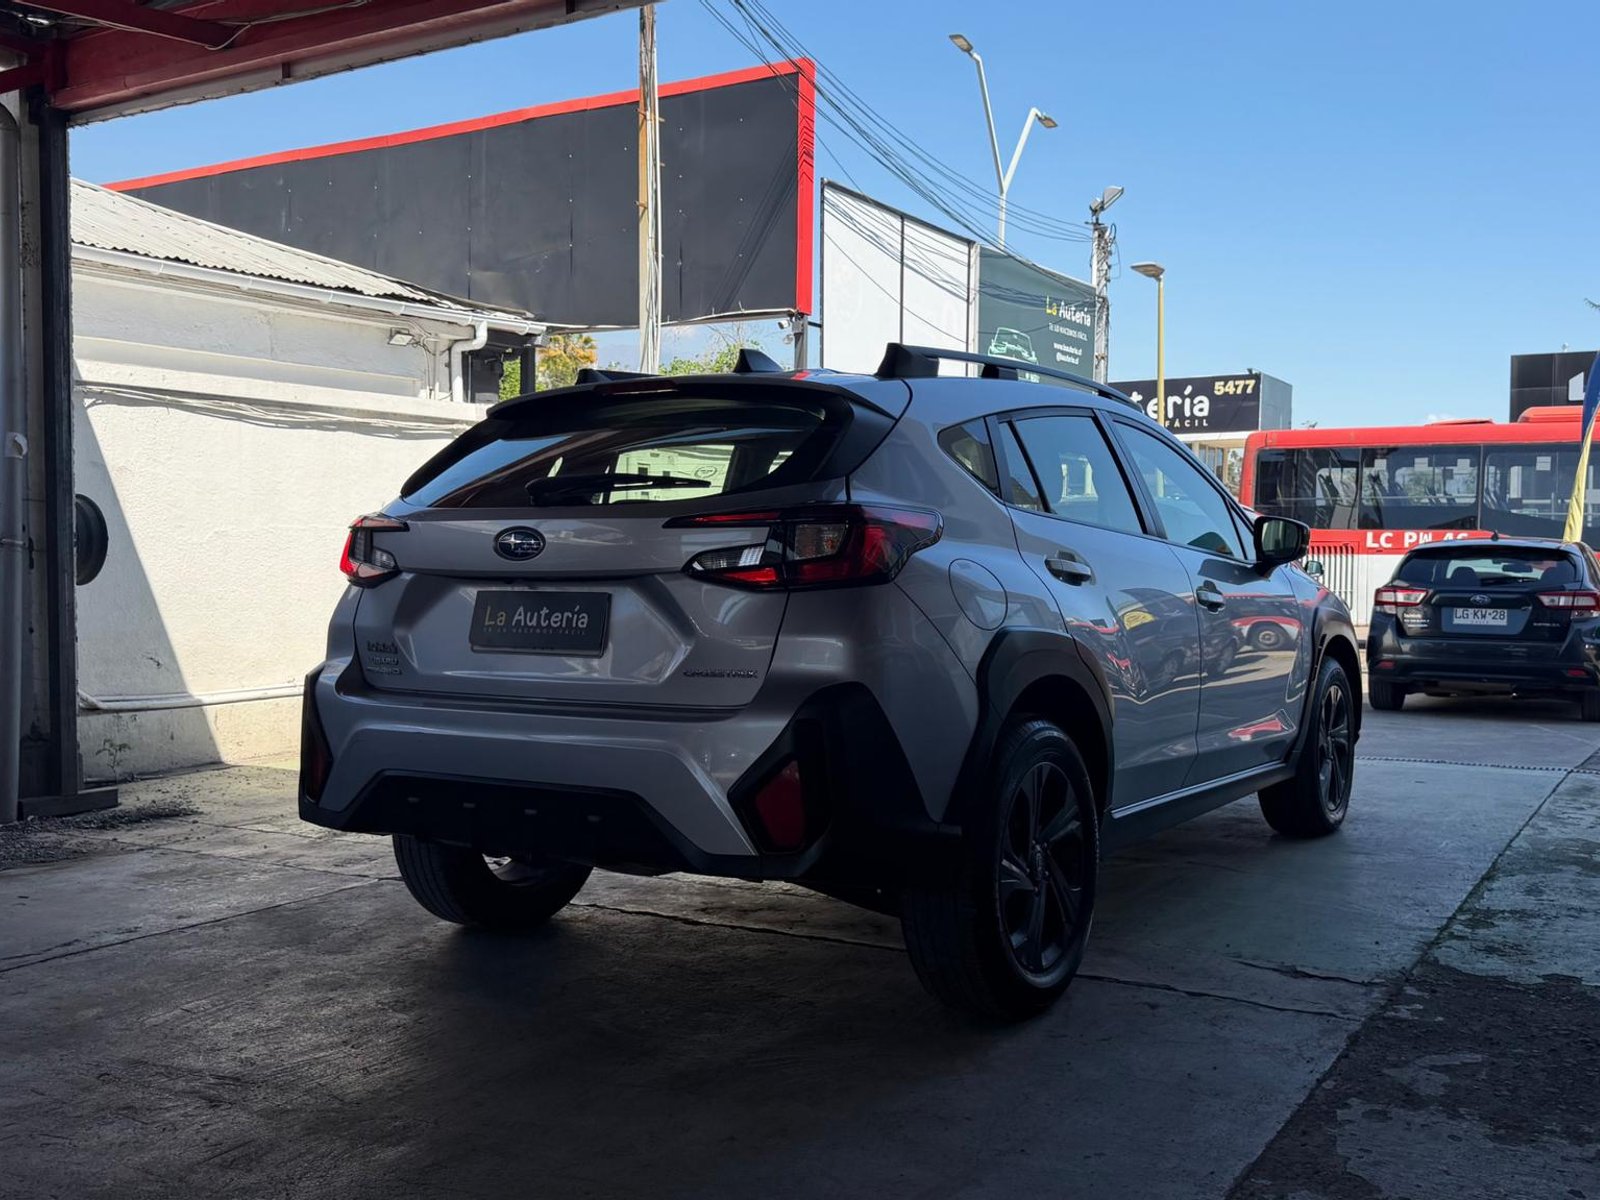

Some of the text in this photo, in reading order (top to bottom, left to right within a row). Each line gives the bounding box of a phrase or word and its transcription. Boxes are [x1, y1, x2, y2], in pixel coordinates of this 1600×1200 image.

[1046, 295, 1057, 315] La
[1214, 379, 1256, 395] 5477
[1165, 418, 1208, 428] FÁCIL
[1366, 531, 1394, 548] LC
[484, 604, 589, 628] La Autería
